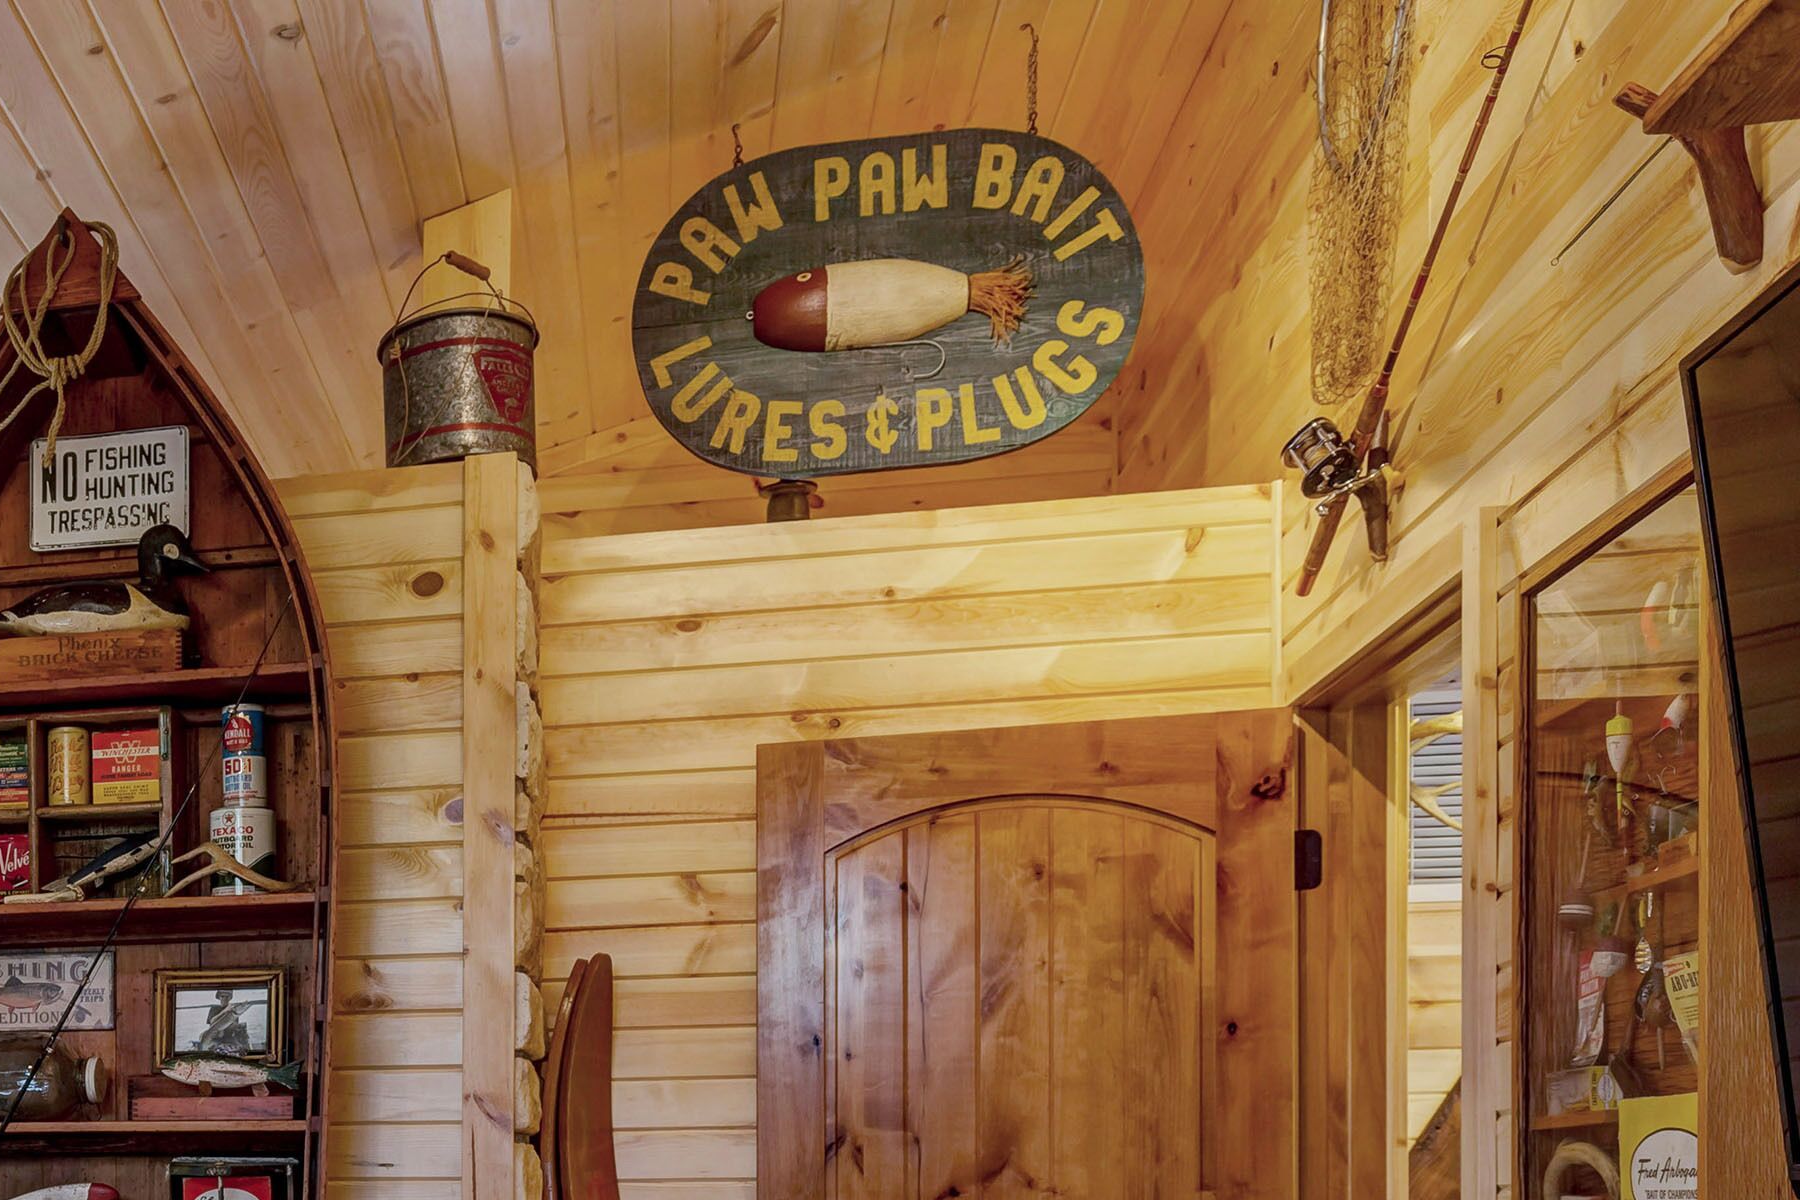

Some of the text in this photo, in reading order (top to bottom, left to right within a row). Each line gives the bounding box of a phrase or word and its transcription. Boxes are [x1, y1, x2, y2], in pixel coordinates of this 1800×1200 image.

[649, 143, 1124, 306] PAW PAW BAIT
[650, 334, 846, 463] LURES
[916, 300, 1125, 452] PLUGS
[41, 442, 167, 505] NO FISHING
[85, 470, 174, 501] HUNTING
[48, 501, 171, 535] TRESPASSING
[58, 636, 121, 654] Phenix
[17, 646, 163, 667] BRICK CHEESE
[100, 747, 151, 757] WINCHESTER
[112, 764, 142, 773] RANGER
[212, 825, 254, 837] TEXACO
[79, 995, 105, 1003] TRIPS
[1637, 1156, 1698, 1185] Fred Arboga
[1659, 1189, 1667, 1199] OF
